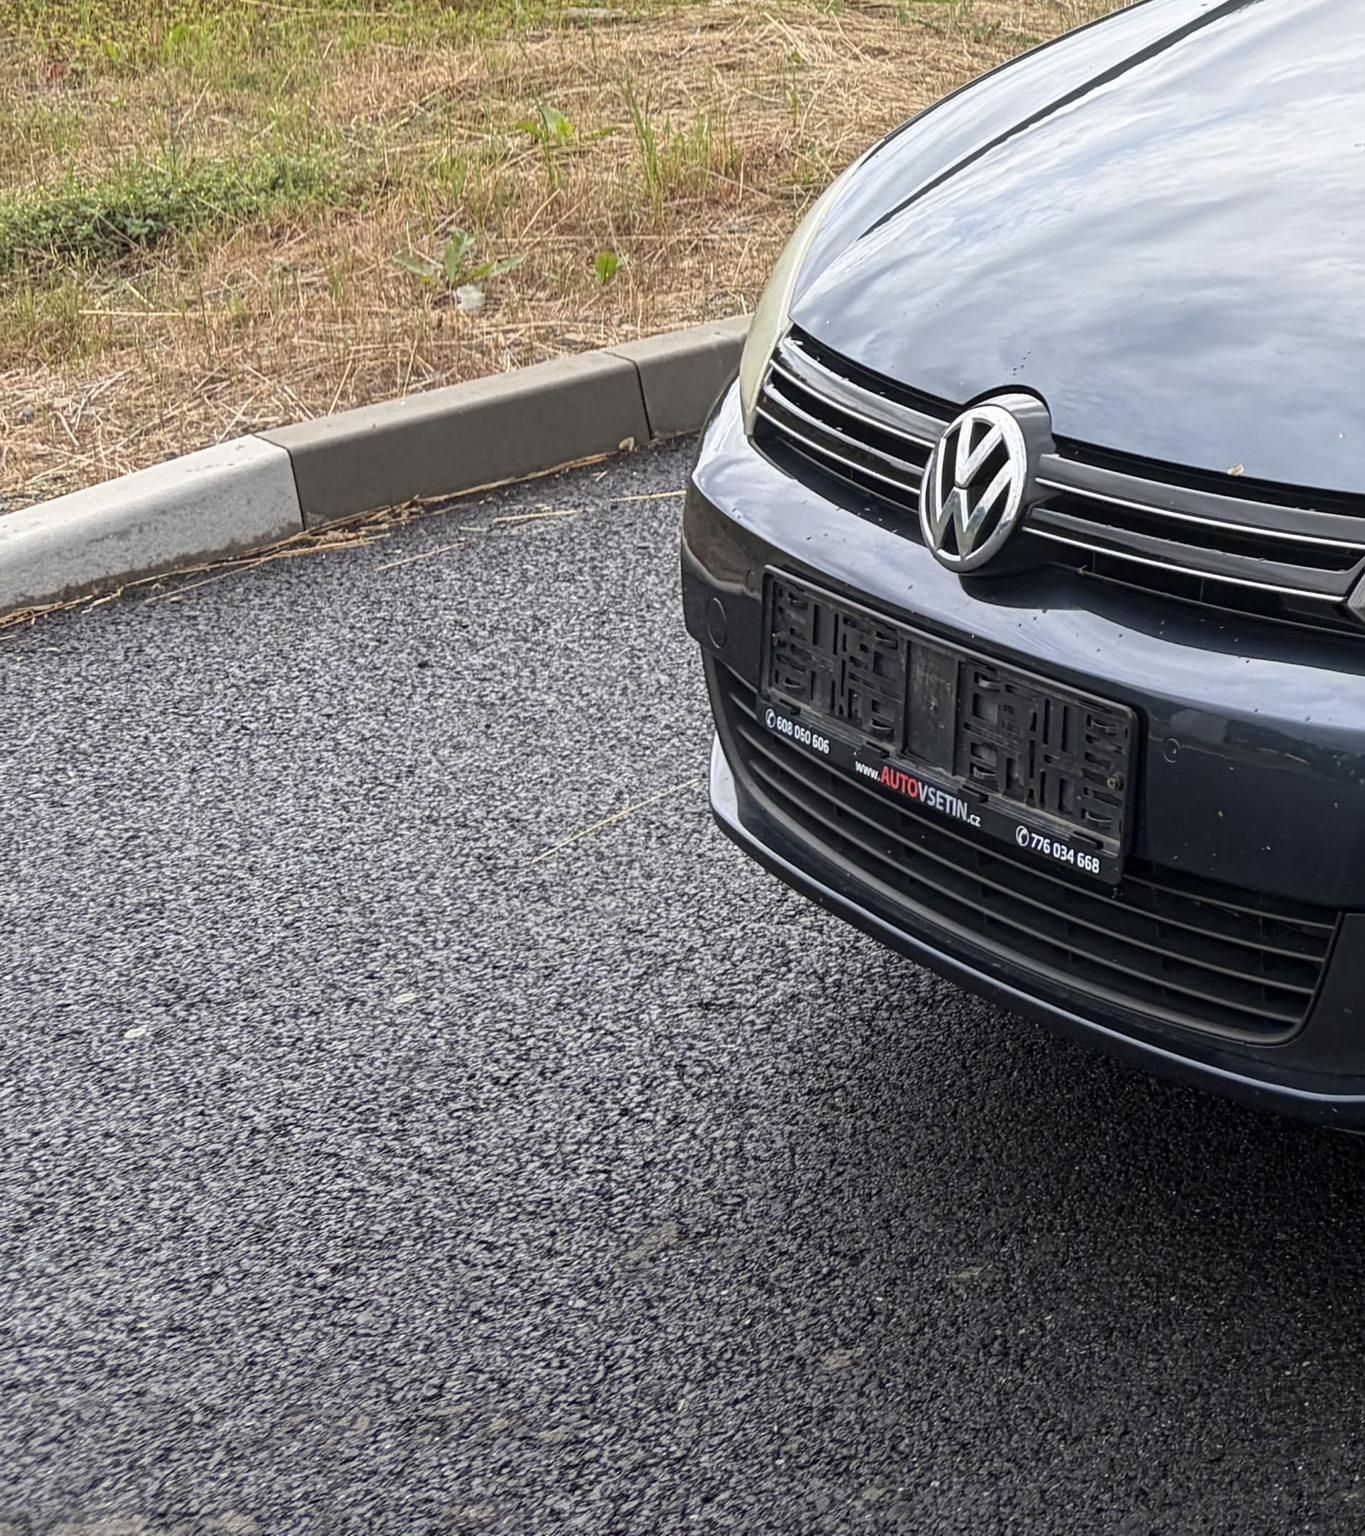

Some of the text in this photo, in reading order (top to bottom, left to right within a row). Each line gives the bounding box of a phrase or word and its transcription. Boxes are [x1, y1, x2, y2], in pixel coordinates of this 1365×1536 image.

[777, 716, 793, 736] 608
[812, 734, 829, 754] 606
[1031, 833, 1100, 874] 776 034 668
